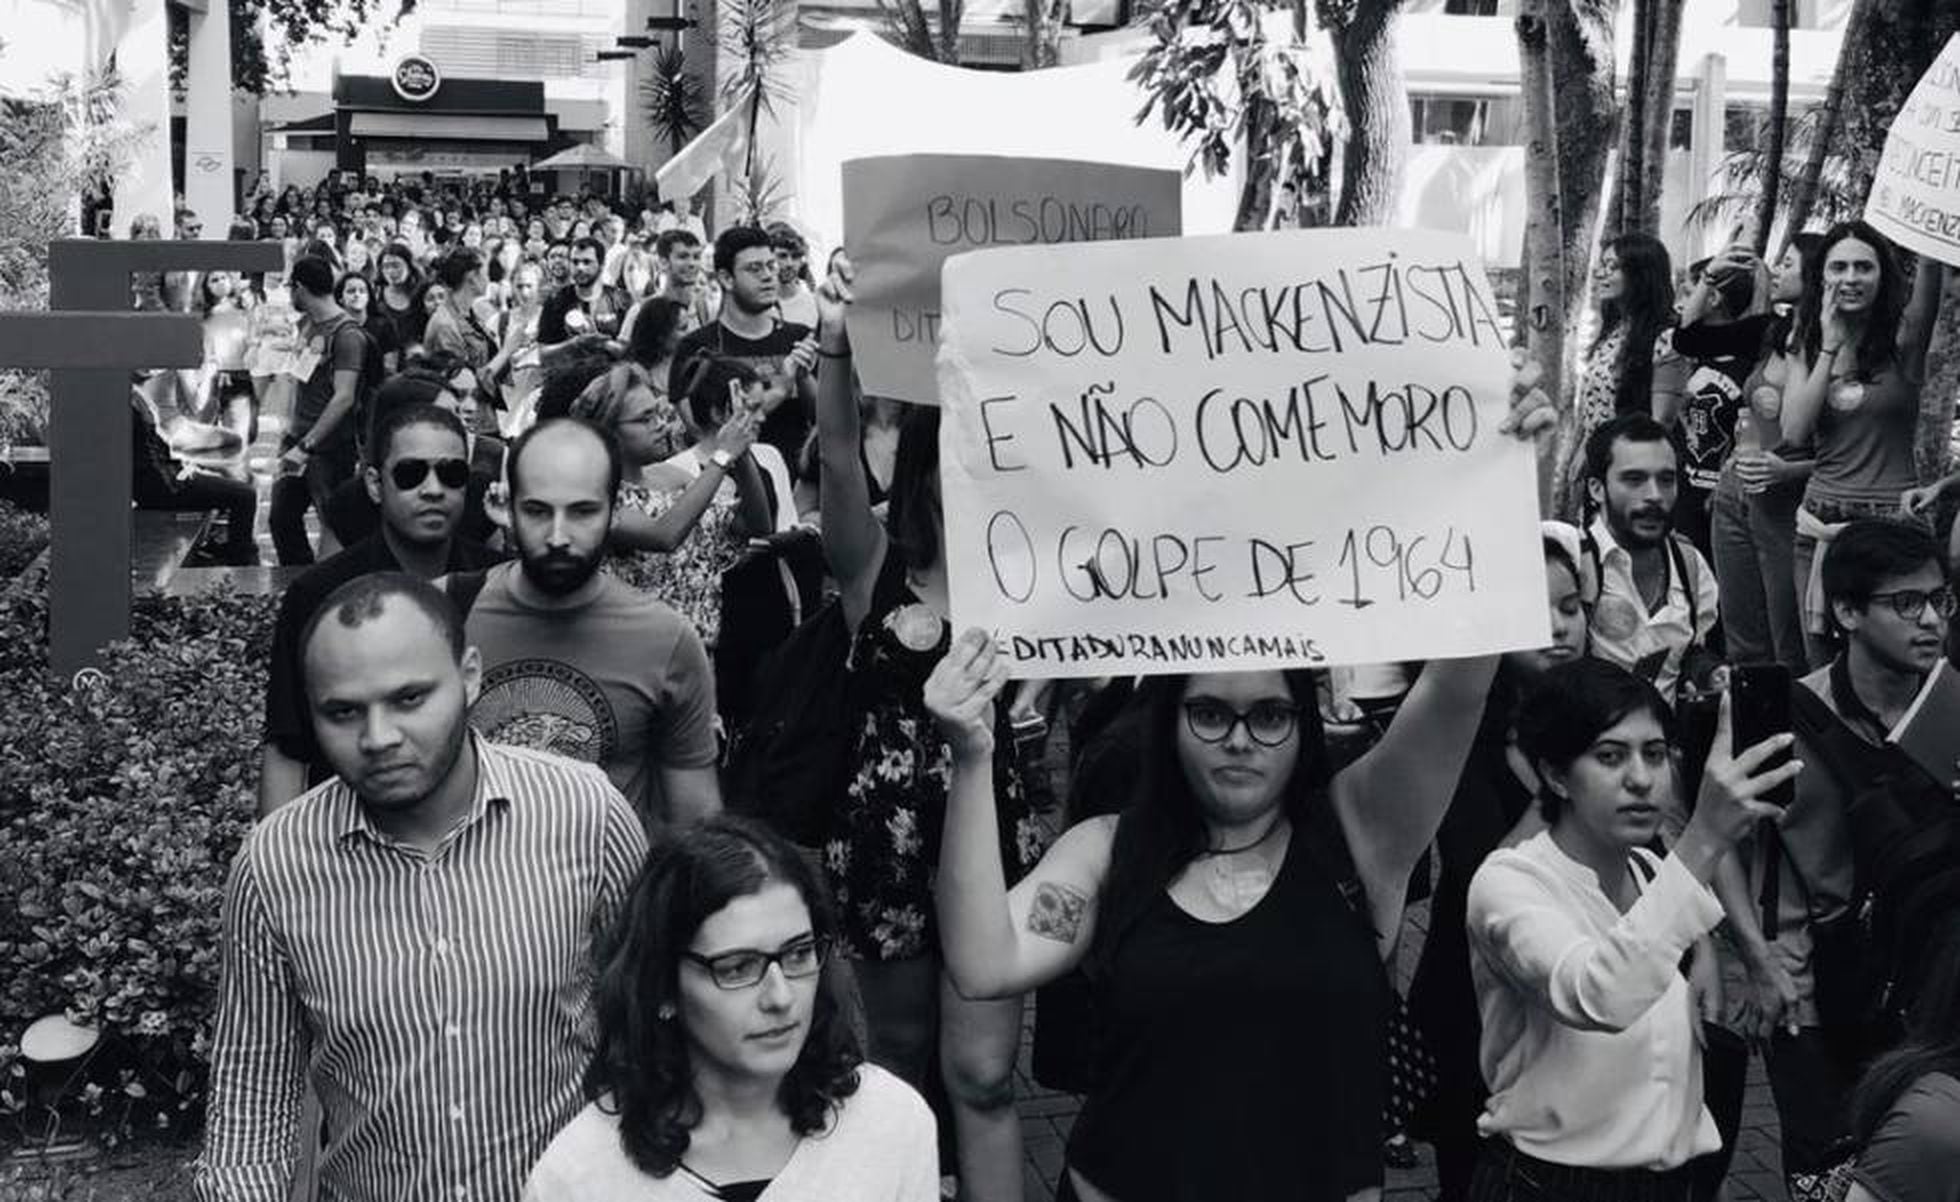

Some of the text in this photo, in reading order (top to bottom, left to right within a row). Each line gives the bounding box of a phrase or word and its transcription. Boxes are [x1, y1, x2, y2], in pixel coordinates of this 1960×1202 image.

[928, 194, 1149, 246] BOLSONARO
[992, 251, 1505, 361] SOU MACKENZISTA
[981, 373, 1478, 473] E NÃO COMEMORO
[986, 509, 1475, 610] O GOLPE DE 1964
